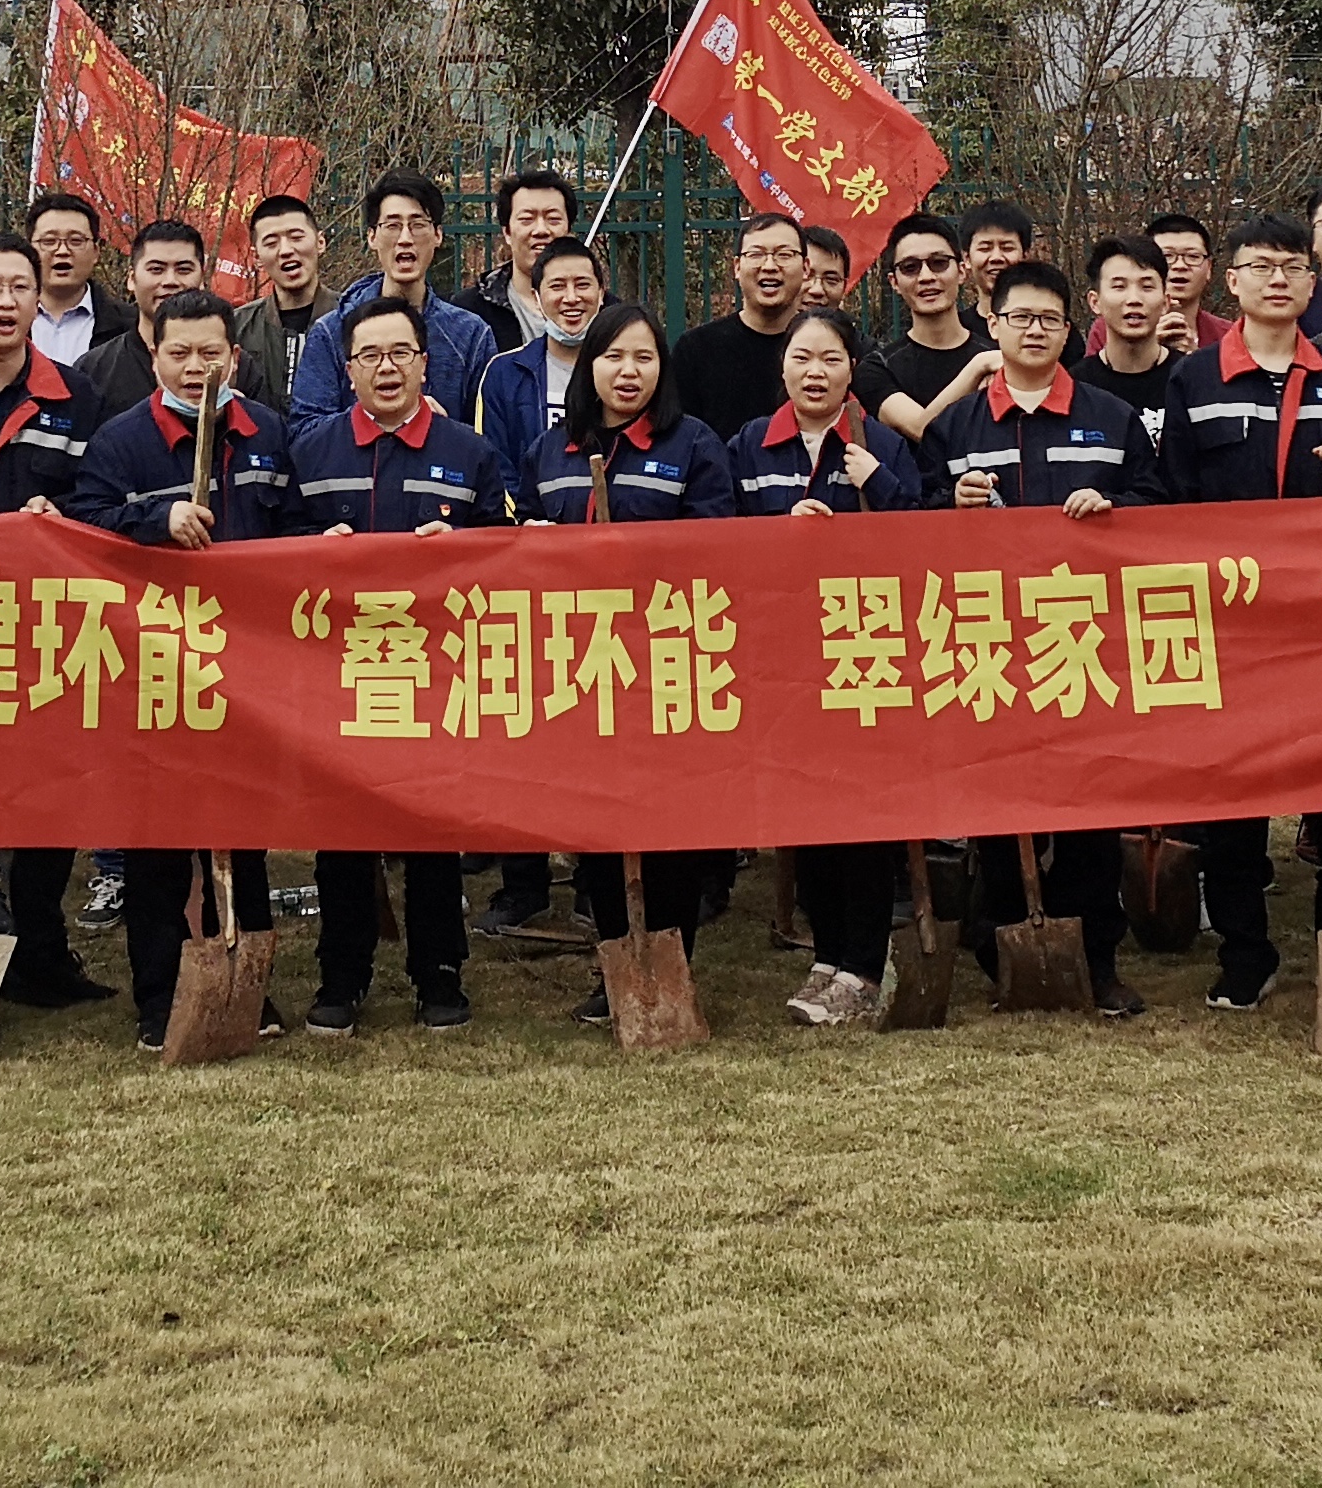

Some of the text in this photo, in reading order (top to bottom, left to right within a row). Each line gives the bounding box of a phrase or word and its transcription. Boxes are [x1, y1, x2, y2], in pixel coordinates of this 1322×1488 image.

[734, 49, 890, 219] 第一党支部
[291, 578, 743, 739] “叠润环能
[818, 556, 1261, 728] 翠绿家园”
